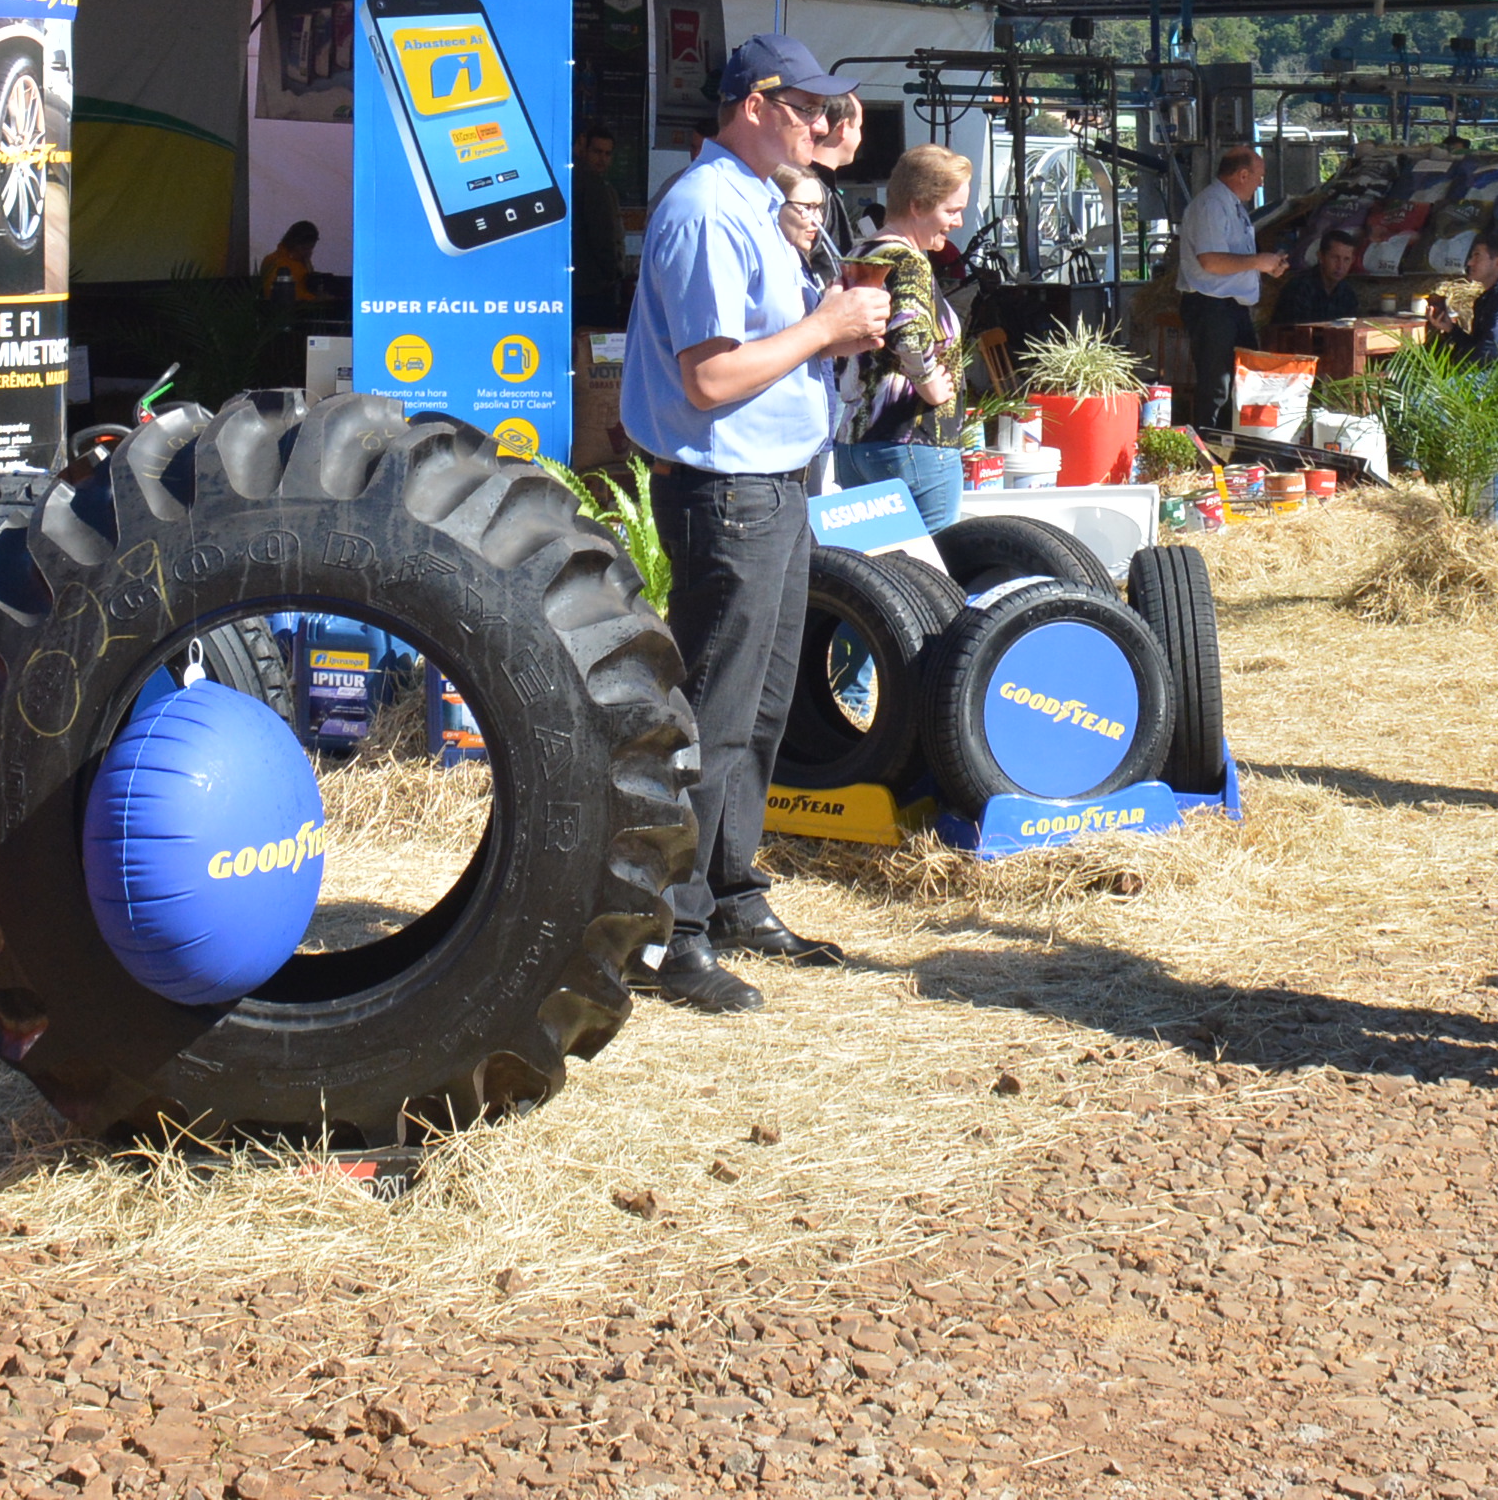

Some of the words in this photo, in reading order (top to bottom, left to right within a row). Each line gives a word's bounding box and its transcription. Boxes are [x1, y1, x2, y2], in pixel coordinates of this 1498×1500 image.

[403, 37, 467, 51] Abastece
[361, 300, 421, 313] SUPER
[427, 297, 479, 313] FÁCIL
[484, 300, 509, 313] DE
[514, 300, 564, 313] USAR
[20, 311, 40, 337] F1
[415, 390, 426, 398] na
[427, 388, 447, 398] hora
[477, 388, 498, 398] Mais
[499, 388, 542, 398] desconto
[544, 390, 553, 398] na
[404, 400, 448, 409] tecimento
[473, 400, 510, 411] gasolina
[511, 400, 525, 409] DT
[820, 492, 907, 531] ASSURANCE
[312, 671, 366, 688] IPITUR
[1000, 682, 1126, 741] GOODYEAR
[767, 794, 845, 816] ODYEAR
[1021, 806, 1146, 837] GOODYEAR
[207, 820, 325, 879] GOODYE
